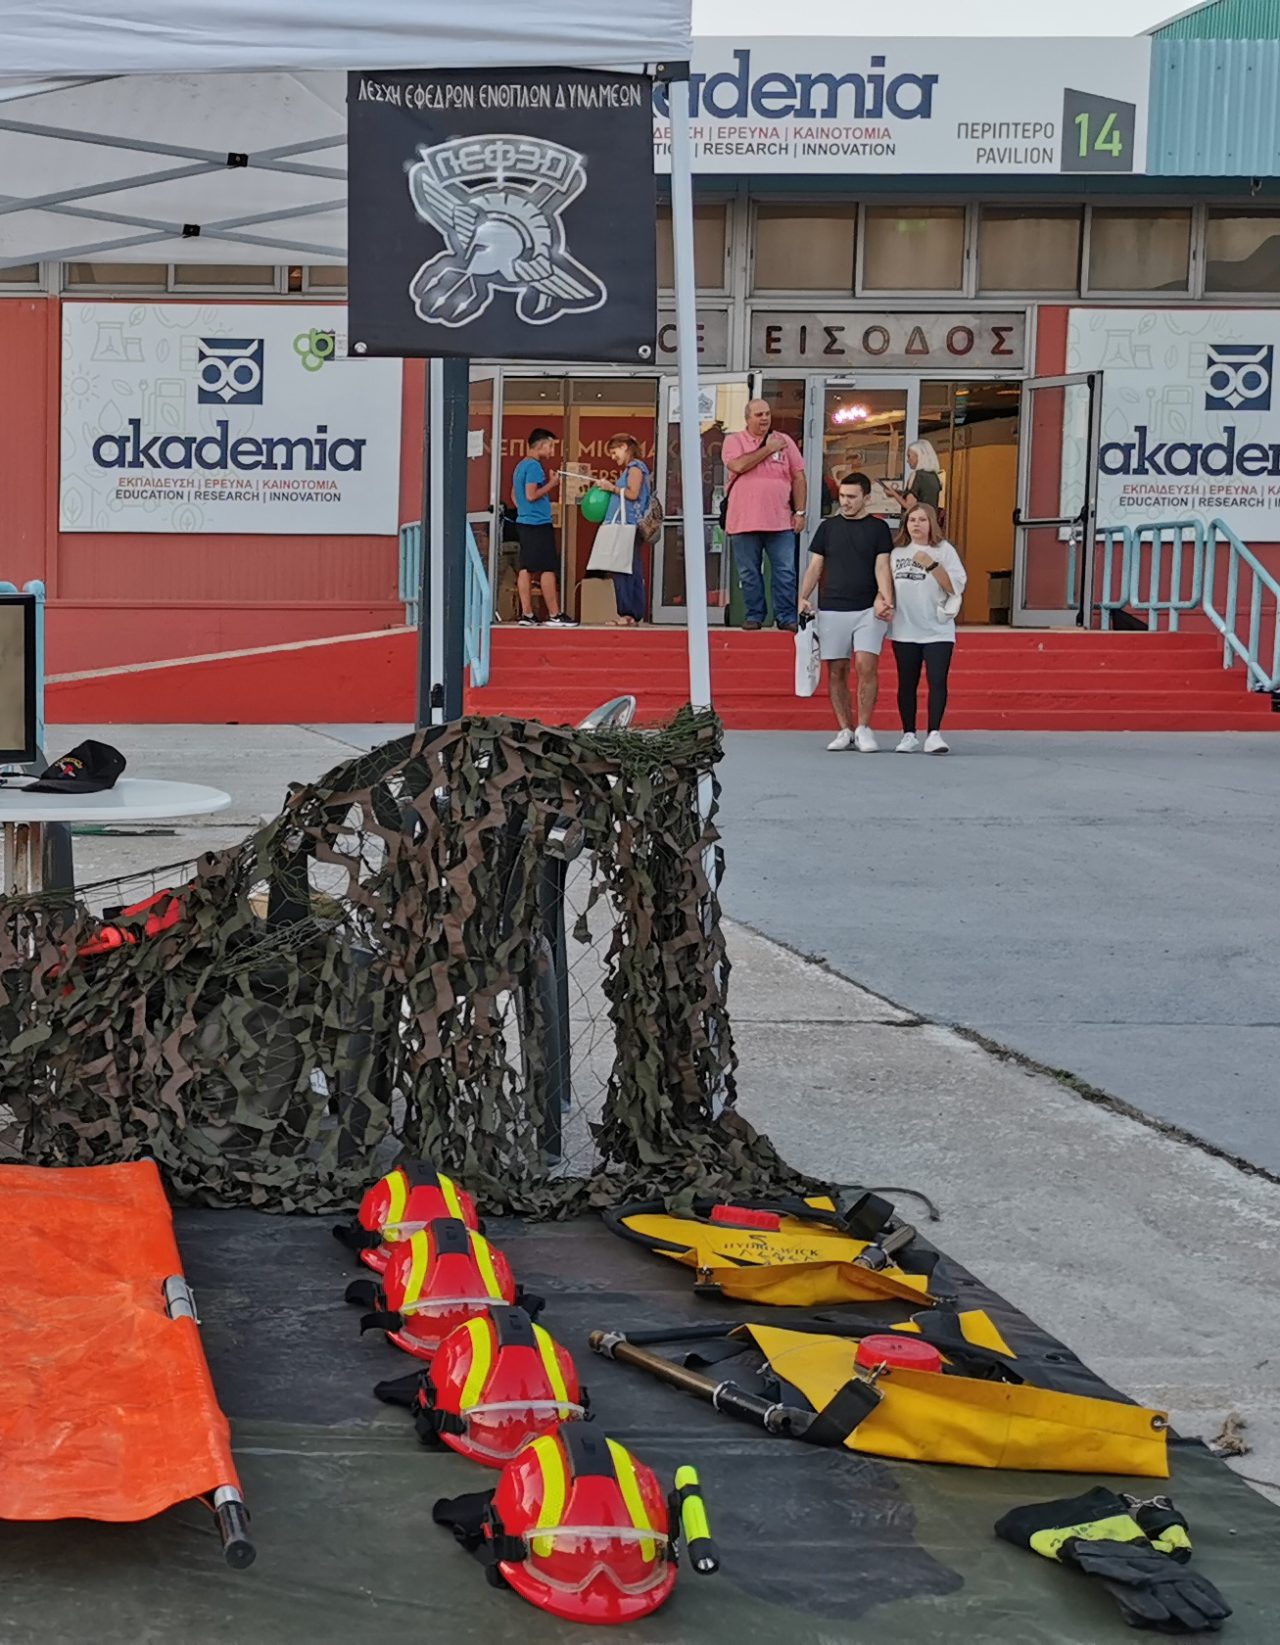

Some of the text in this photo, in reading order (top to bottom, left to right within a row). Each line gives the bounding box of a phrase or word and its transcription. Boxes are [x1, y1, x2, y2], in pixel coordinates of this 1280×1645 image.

[358, 79, 401, 106] ΛΕΣΧΗ
[405, 84, 474, 109] ΕΦΕΔΡΩΝ
[555, 83, 642, 109] ΔΥΝΑΜΕΩΝ
[718, 126, 780, 139] ΕΡΕΥΝΑ
[793, 127, 892, 140] ΚΑΙΝΟΤΟΜΙΑ
[956, 122, 1055, 139] ΠΕΡΙΠΤΕΡΟ
[1074, 112, 1123, 157] 14
[703, 142, 896, 156] RESEARCH INNOVATION
[976, 147, 1054, 164] PAVILION
[765, 325, 1015, 356] ΕΙΣΟΔΟΣ
[92, 418, 367, 472] akademia
[1099, 425, 1280, 477] akade
[118, 477, 338, 491] ΕΚΠΑΙΔΕΥΣΗ ΕΡΕΥΝΑ ΚΑΙΝΟΤΟΜΙΑ
[1123, 484, 1200, 495] ΕΚΠΑΙΔΕΥΣΗ
[1210, 484, 1258, 495] ΕΡΕΥΝΑ
[115, 489, 341, 503] EDUCATION RESEARCH INNOVATION
[1119, 496, 1188, 507] EDUCATION
[1198, 497, 1265, 508] RESEARCH
